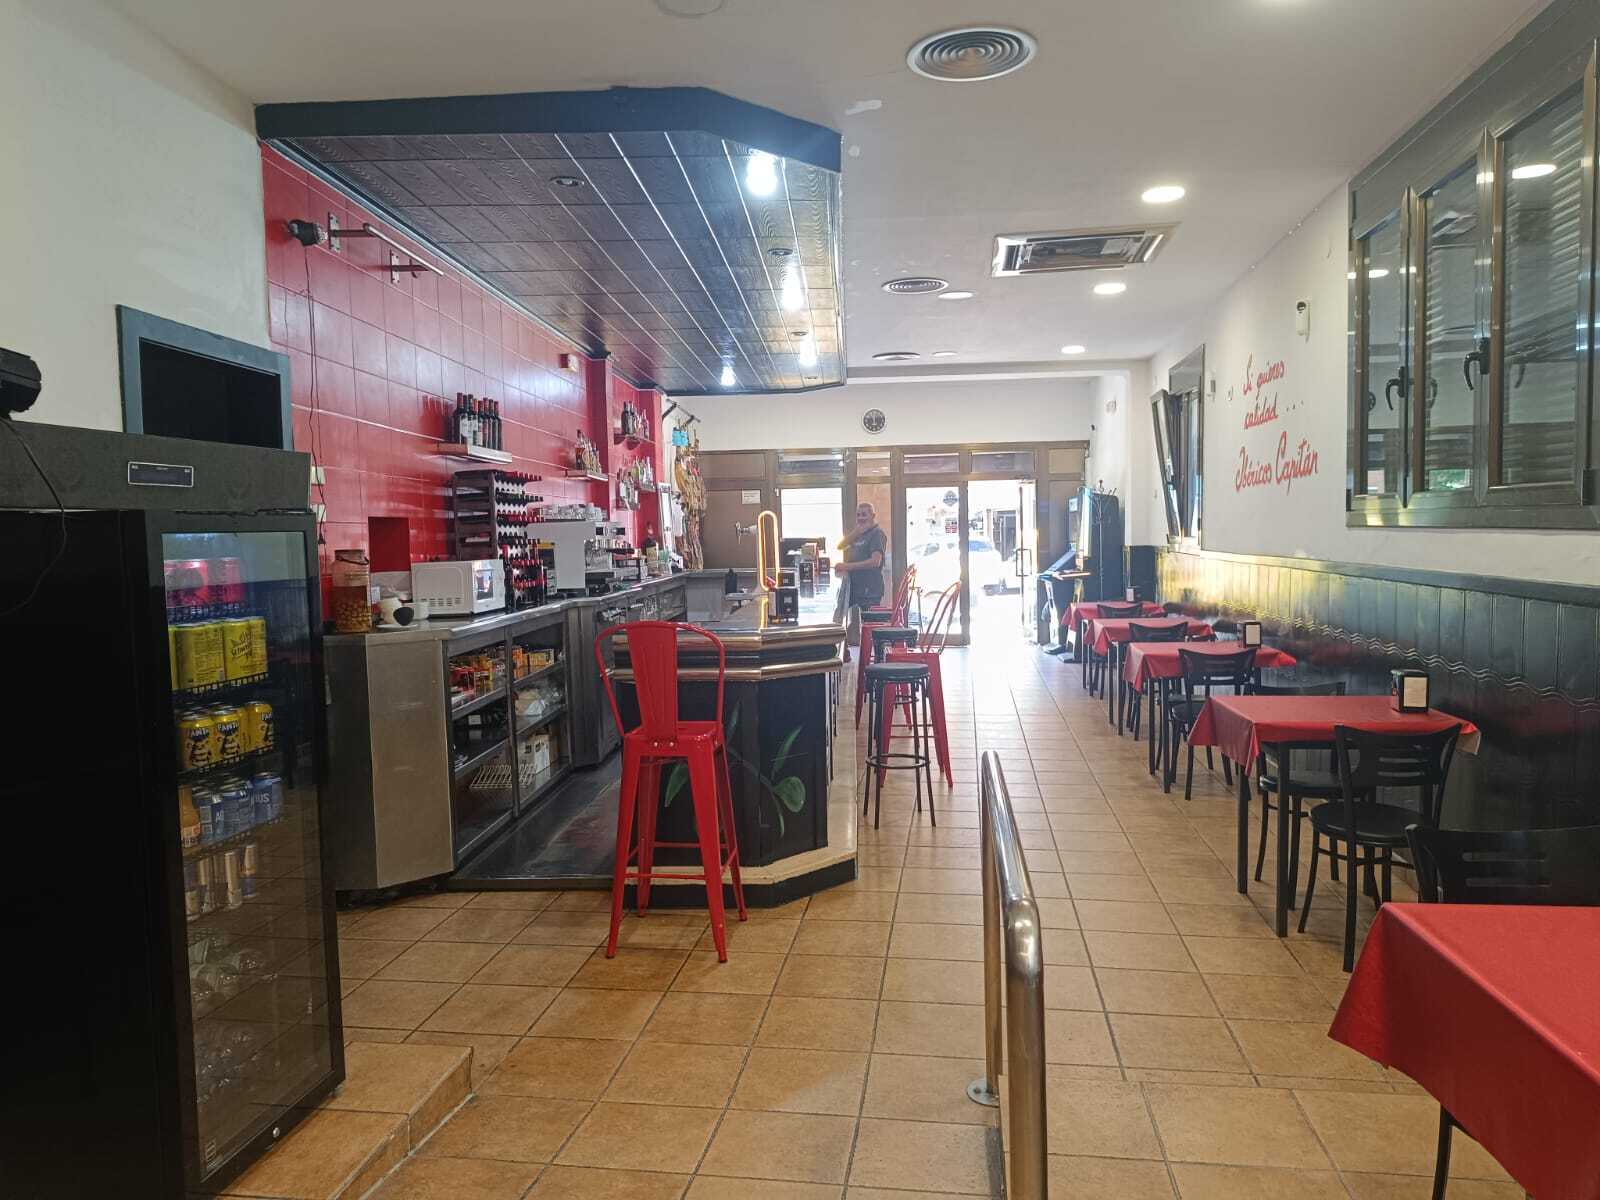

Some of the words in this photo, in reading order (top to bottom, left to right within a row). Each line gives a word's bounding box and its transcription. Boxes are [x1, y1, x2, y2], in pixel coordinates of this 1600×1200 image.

[1243, 352, 1253, 395] Si
[1244, 392, 1279, 430] calidad
[1235, 446, 1272, 494] Ibéricos
[1275, 431, 1319, 496] Capitán
